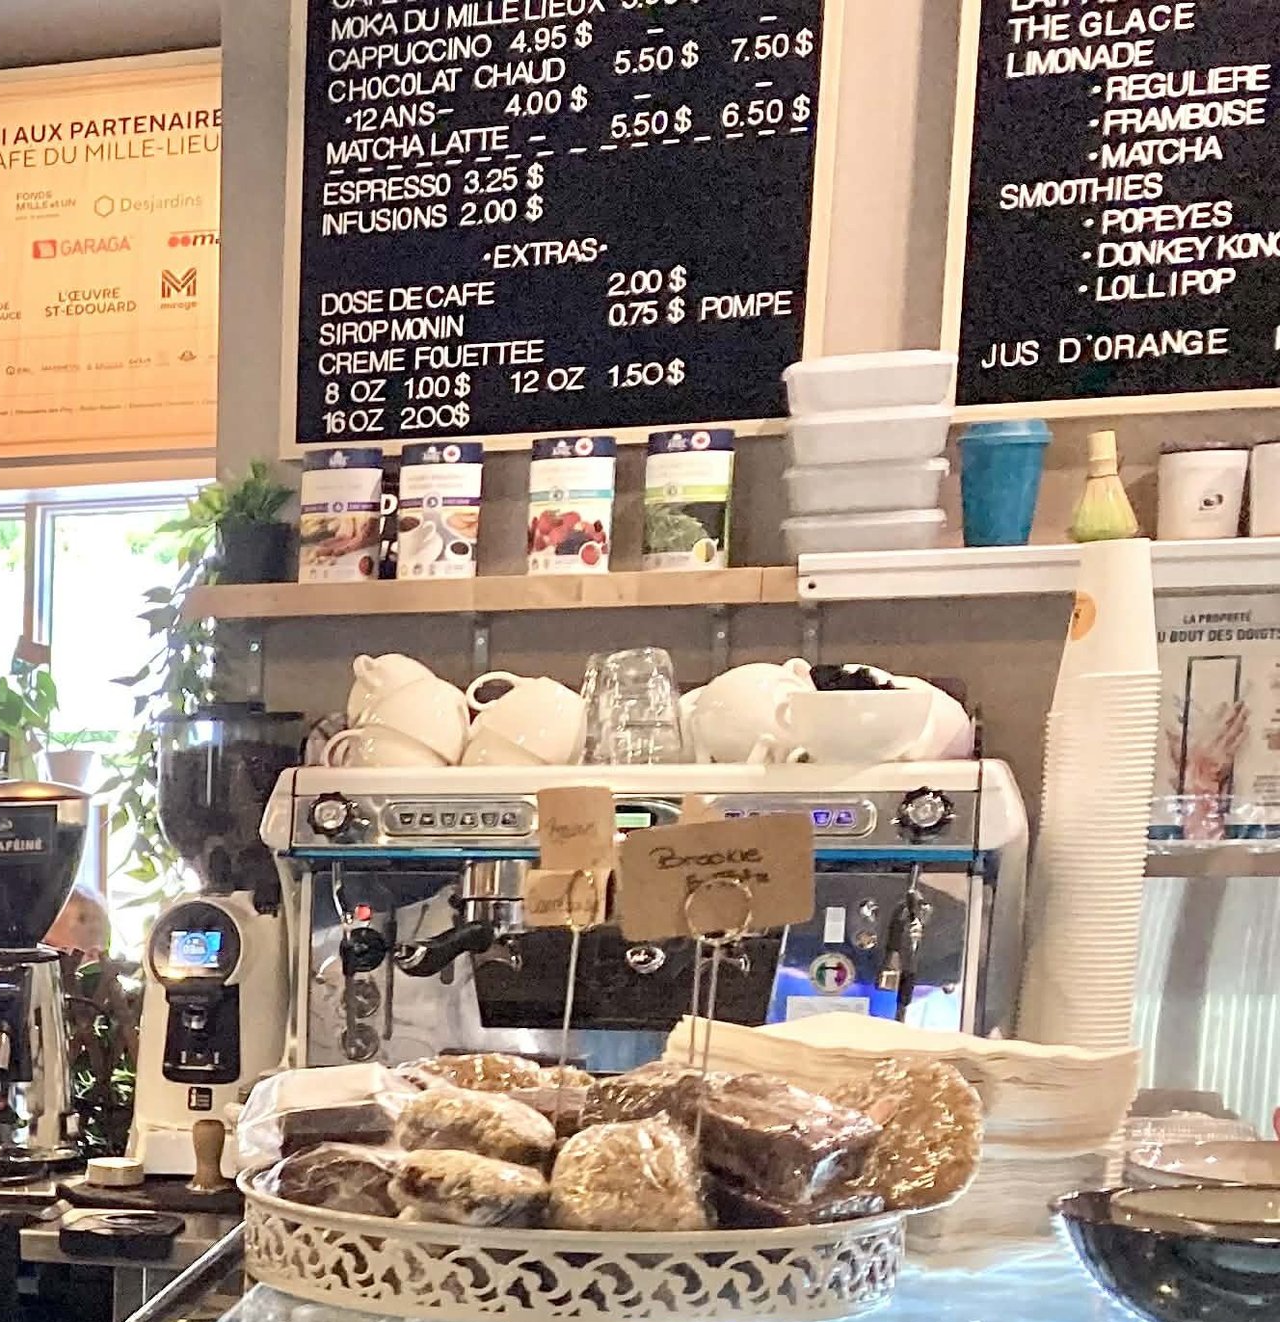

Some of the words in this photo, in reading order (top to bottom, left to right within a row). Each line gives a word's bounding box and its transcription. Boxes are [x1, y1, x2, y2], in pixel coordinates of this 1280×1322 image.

[331, 12, 398, 41] MOKA
[404, 8, 440, 34] DU
[447, 0, 520, 29] MILLE
[1008, 13, 1071, 44] THE
[1079, 2, 1196, 39] GLACE
[328, 34, 492, 72] CAPPUCCINO
[509, 25, 568, 54] 4.95
[1006, 39, 1155, 78] LIMONADE
[328, 68, 463, 103] CHOCOLAT
[474, 58, 566, 89] CHAUD
[614, 46, 674, 74] 5.50
[731, 33, 789, 63] 7.50
[504, 89, 562, 117] 4.00
[13, 123, 63, 145] AUX
[327, 133, 424, 165] MATCHA
[431, 125, 510, 156] LATTE
[610, 110, 668, 139] 5.50
[722, 99, 784, 128] 6.50
[44, 146, 77, 167] DU
[120, 192, 203, 214] Desjardins
[323, 173, 451, 205] ESPRESSO
[464, 166, 518, 195] 3.25
[999, 173, 1163, 210] SMOOTHIES
[322, 204, 447, 237] INFUSIONS
[459, 199, 517, 227] 2.00
[1101, 200, 1234, 235] POPEYES
[60, 236, 132, 256] GARAGA
[1098, 235, 1218, 269] DONKEY
[321, 289, 384, 317] DOSE
[389, 286, 423, 312] DE
[426, 281, 495, 308] CAFE
[607, 269, 663, 297] 2.00
[319, 319, 389, 347] SIROP
[391, 314, 465, 341] MONIN
[608, 300, 658, 327] 0.75
[701, 290, 793, 322] POMPE
[318, 348, 406, 376] CREME
[414, 339, 545, 371] FOUETTEE
[981, 339, 1040, 368] JUS
[324, 382, 340, 405] 8
[350, 379, 387, 403] OZ
[510, 370, 539, 394] 12
[547, 366, 586, 392] OZ
